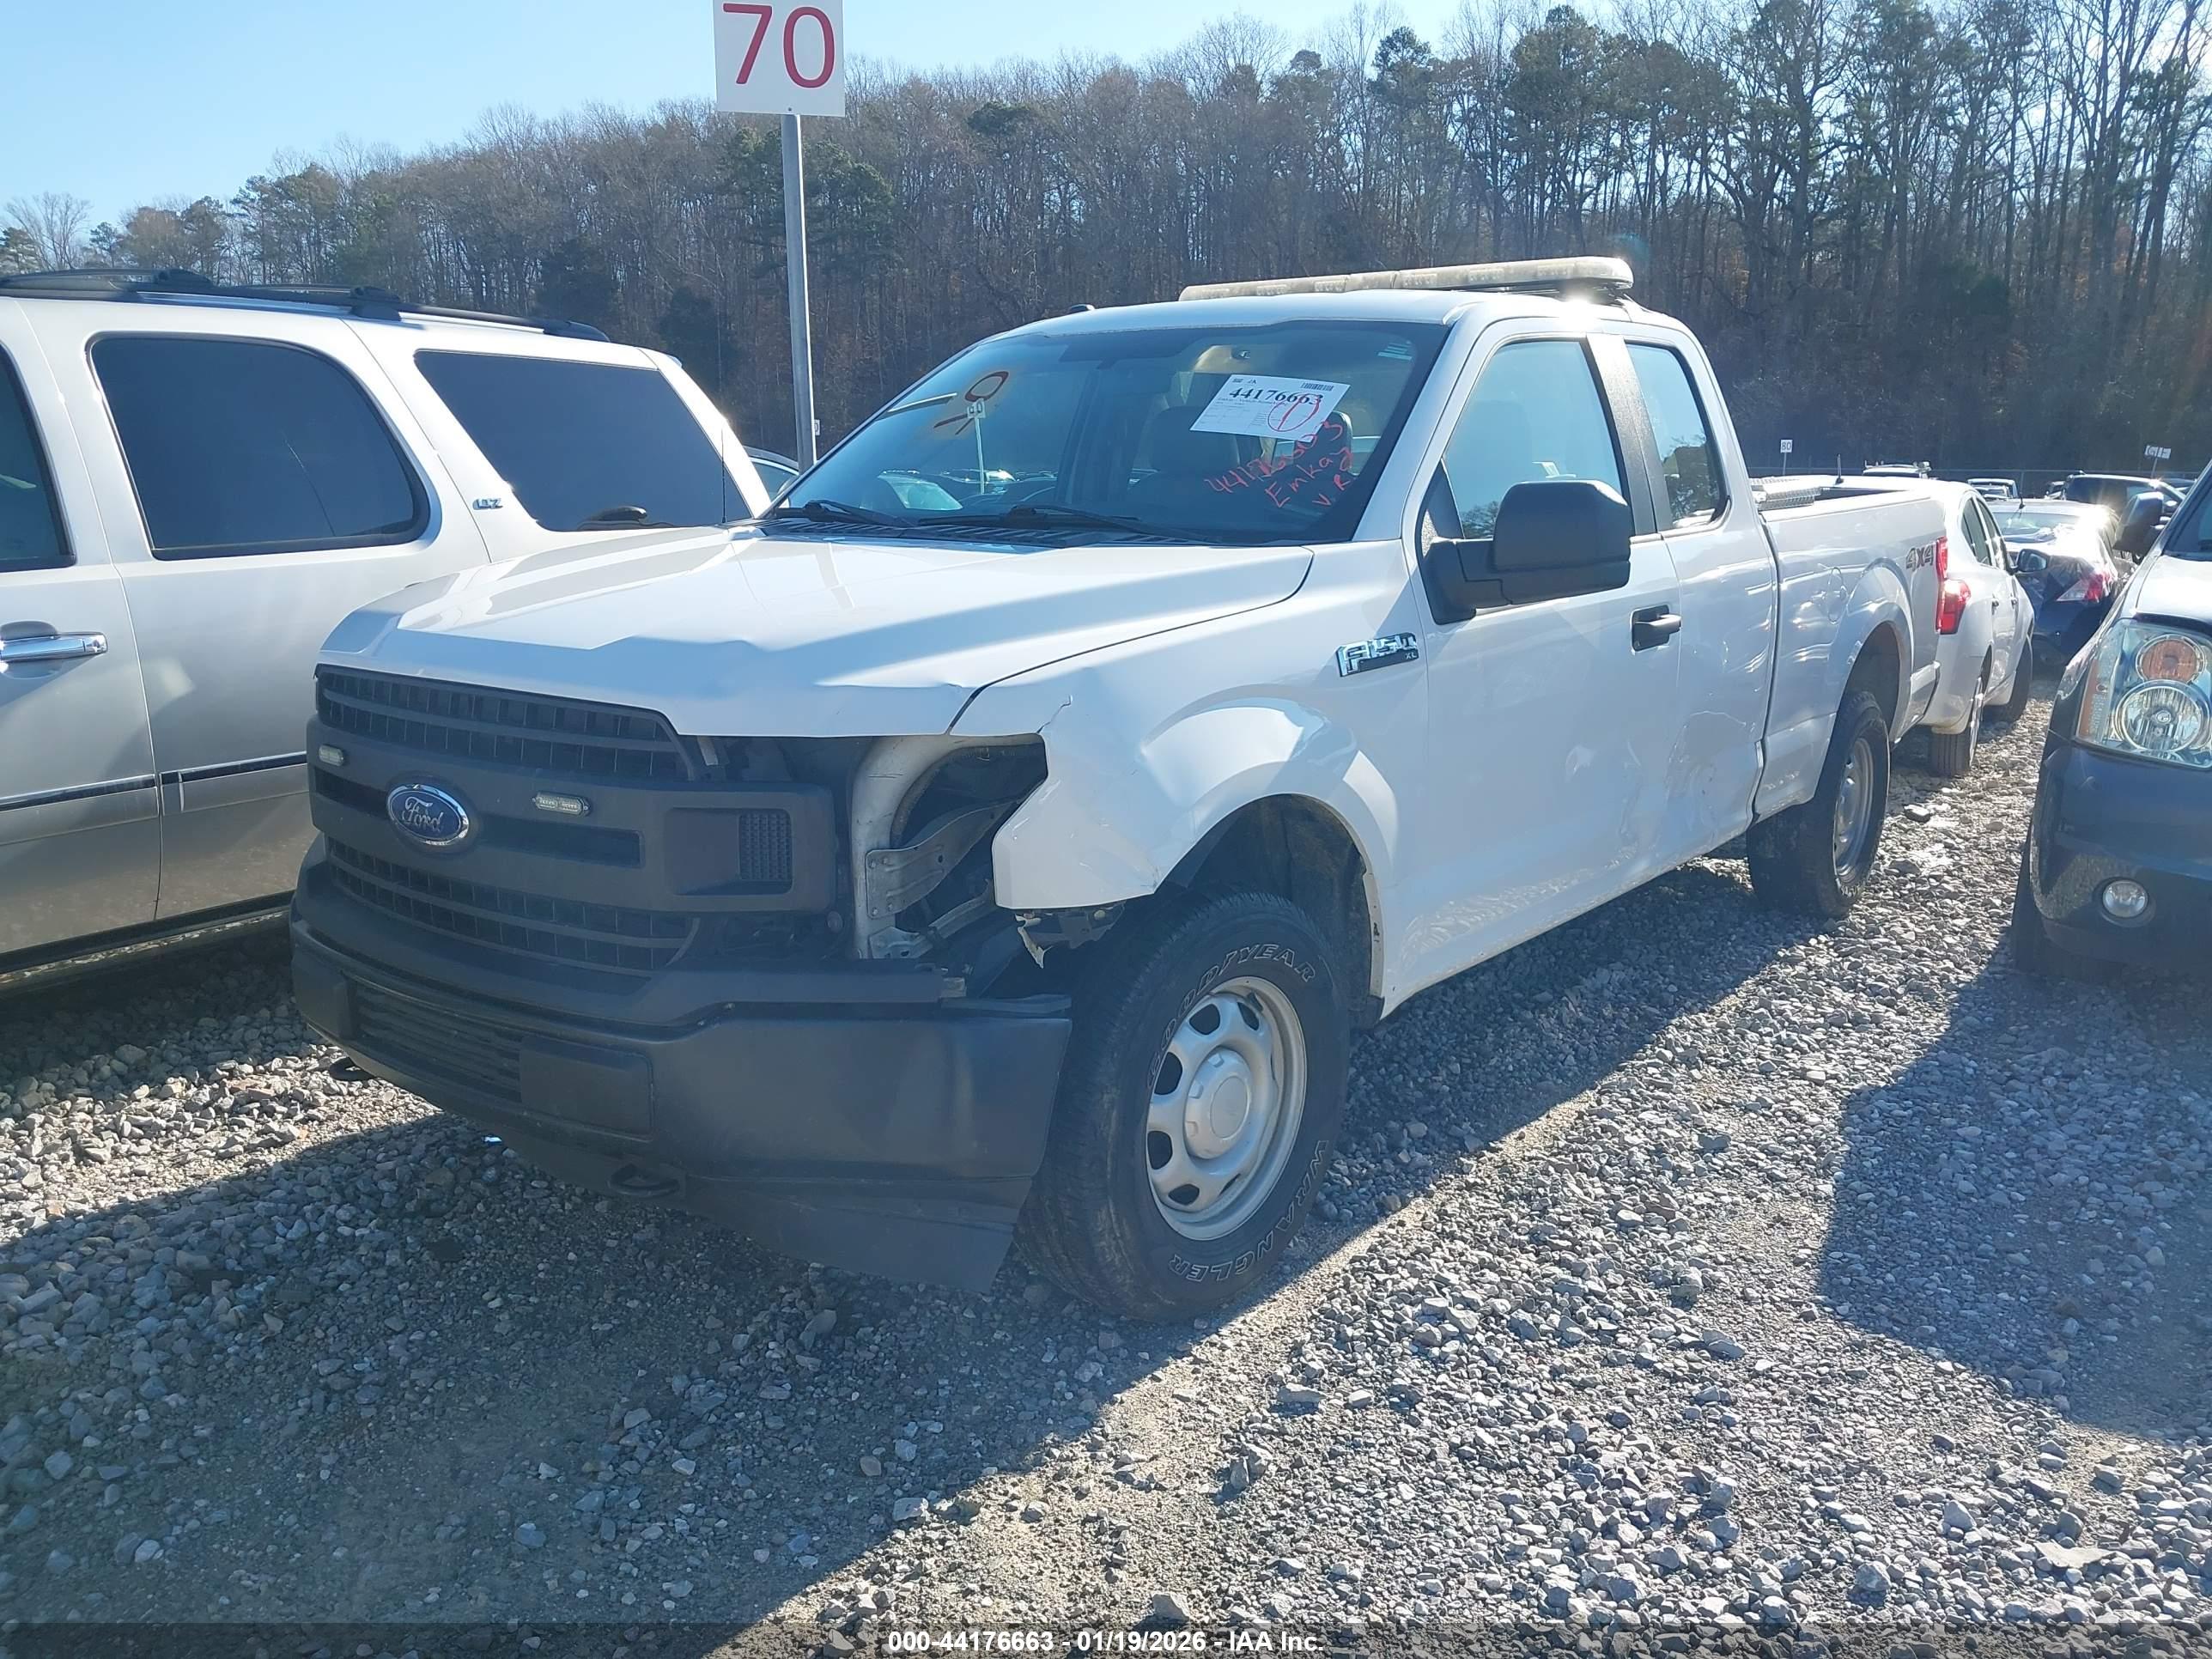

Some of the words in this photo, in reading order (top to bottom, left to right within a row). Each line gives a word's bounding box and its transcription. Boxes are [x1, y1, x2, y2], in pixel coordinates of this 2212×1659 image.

[723, 3, 836, 88] 70
[1229, 387, 1324, 405] 44176663
[401, 796, 445, 832] Ford
[1146, 943, 1316, 1090] GOODYEAR
[1168, 1139, 1330, 1283] WRANGLER
